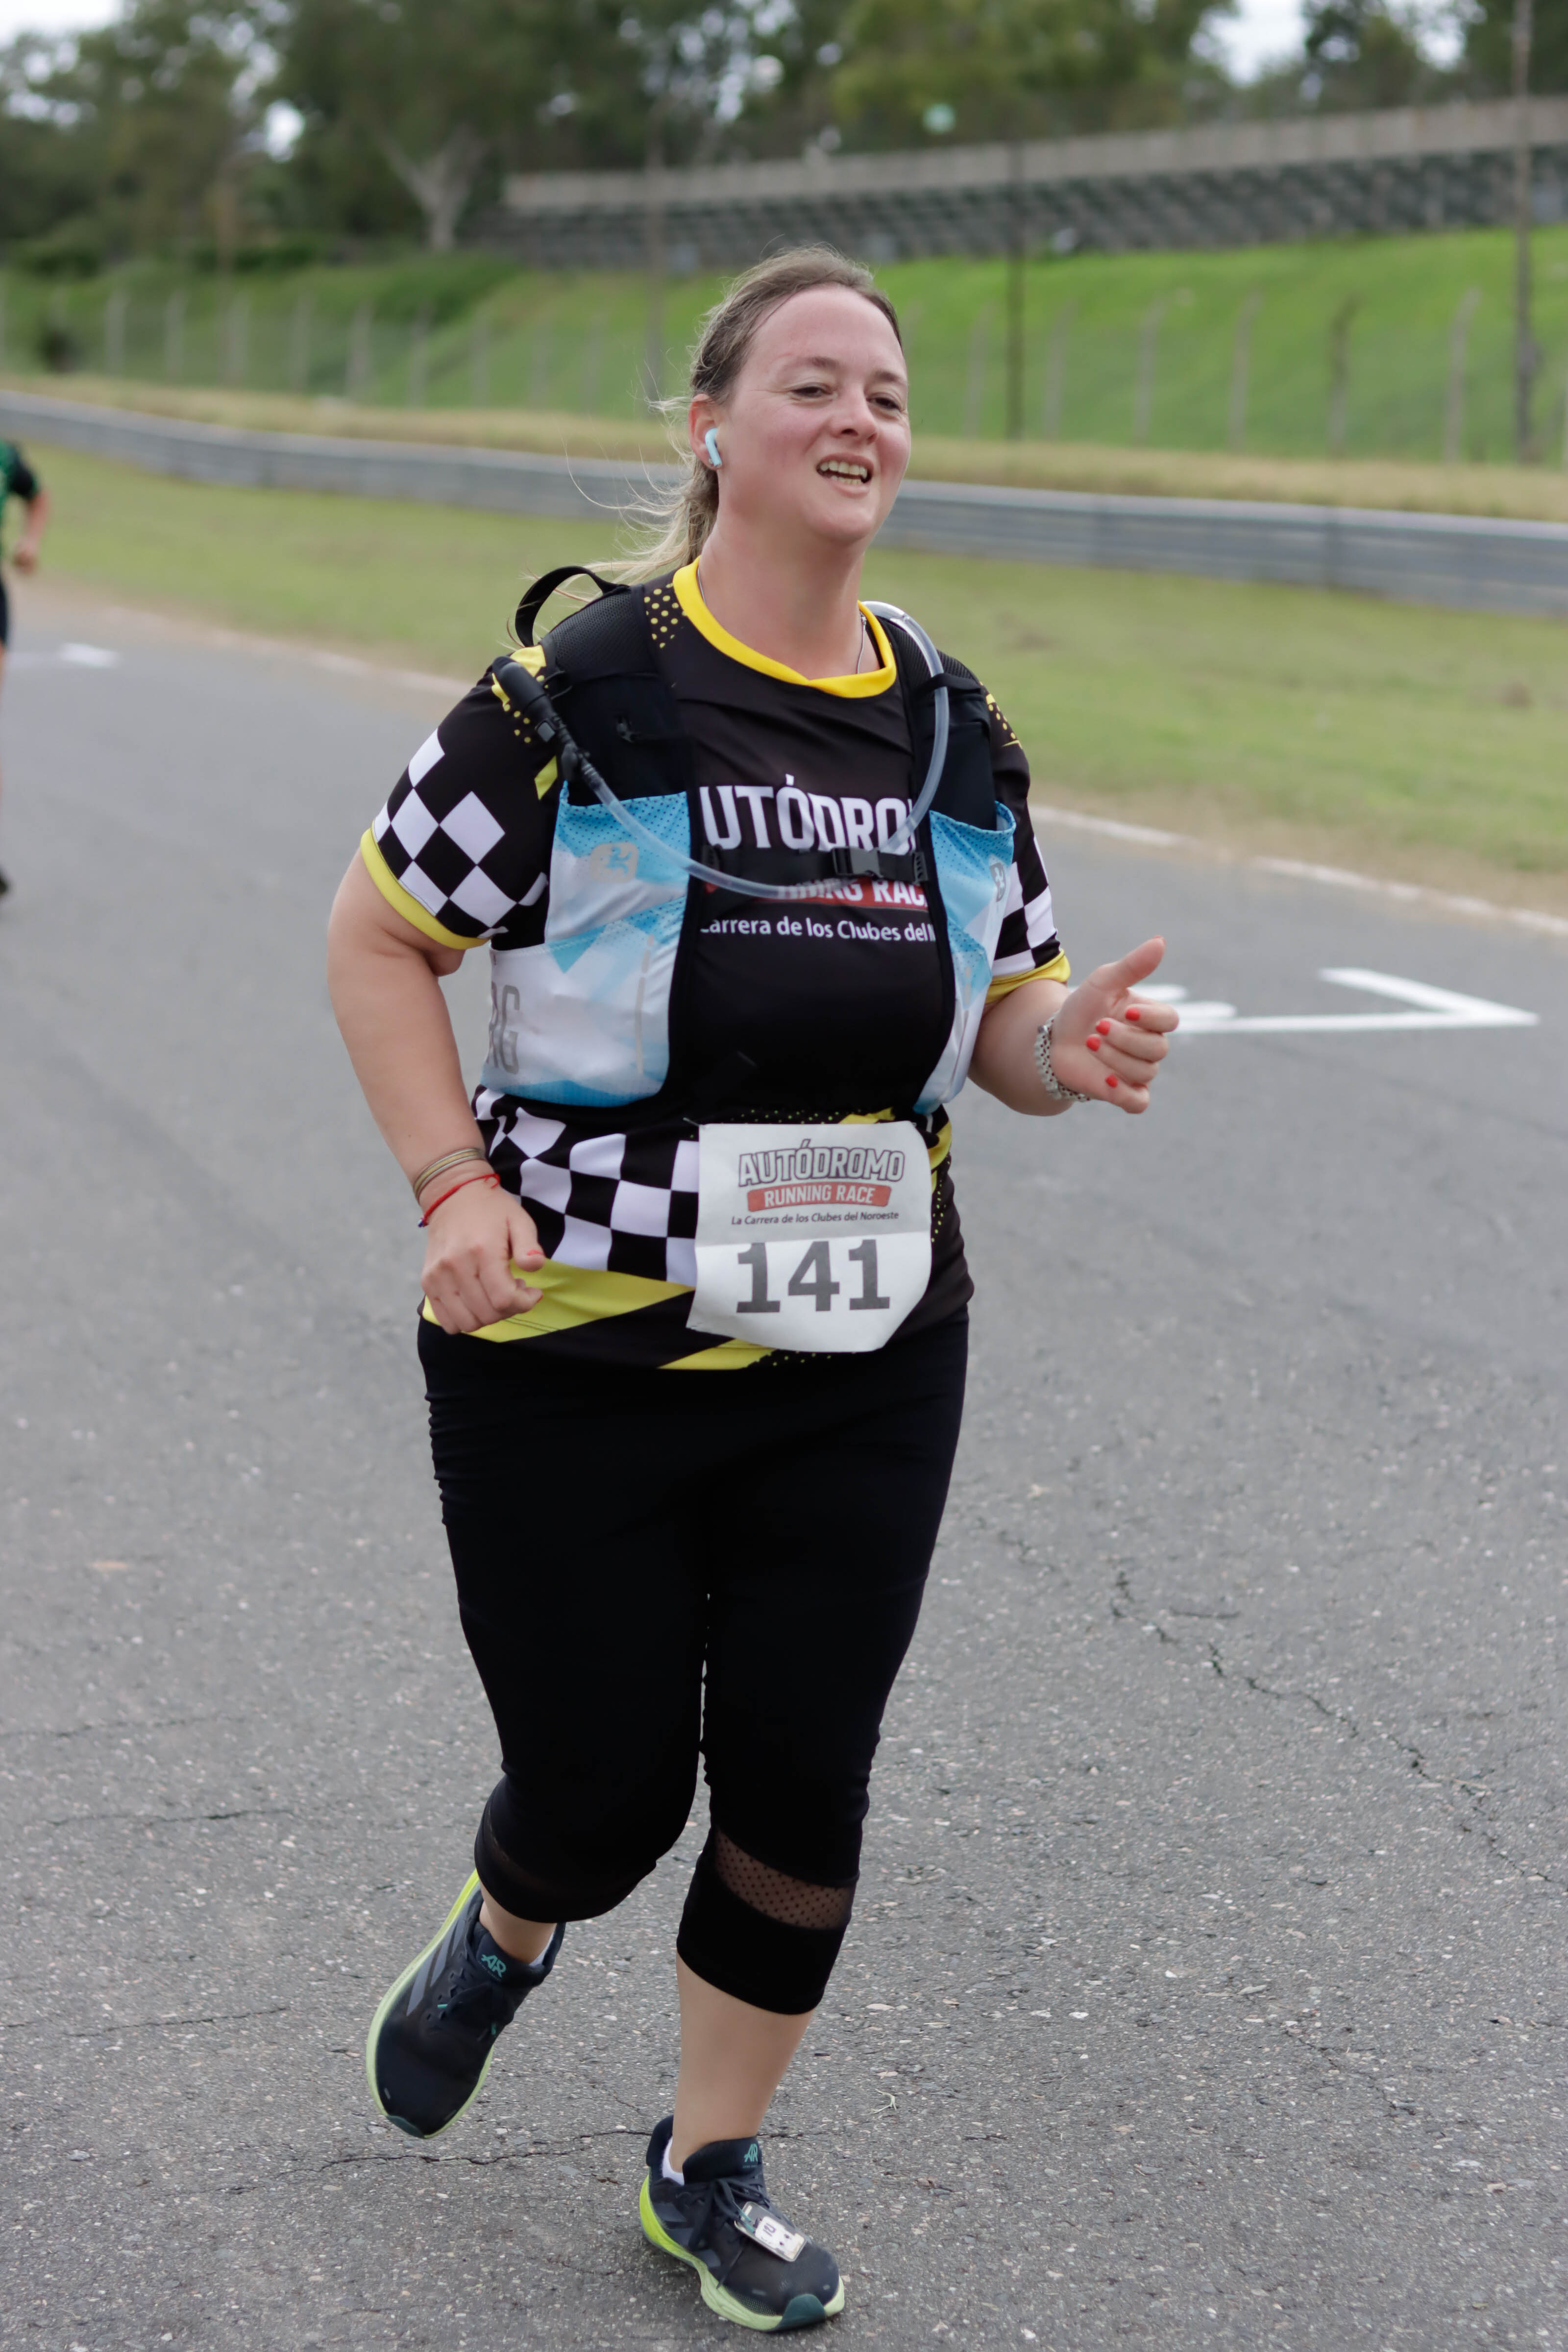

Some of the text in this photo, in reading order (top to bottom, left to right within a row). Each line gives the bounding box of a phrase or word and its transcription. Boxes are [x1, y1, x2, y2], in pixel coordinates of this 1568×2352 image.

[699, 774, 916, 856] UTÓDRO
[871, 880, 929, 907] RAC
[700, 919, 772, 935] arrera
[776, 915, 803, 936] de
[806, 917, 833, 938] los
[836, 920, 901, 941] Clubes
[904, 922, 928, 942] del
[738, 1138, 905, 1187] AUTÓDROMO
[763, 1184, 876, 1207] RUNNING RACE
[731, 1211, 900, 1225] La Carrera de los Clubes del Noroeste
[735, 1239, 891, 1314] 141
